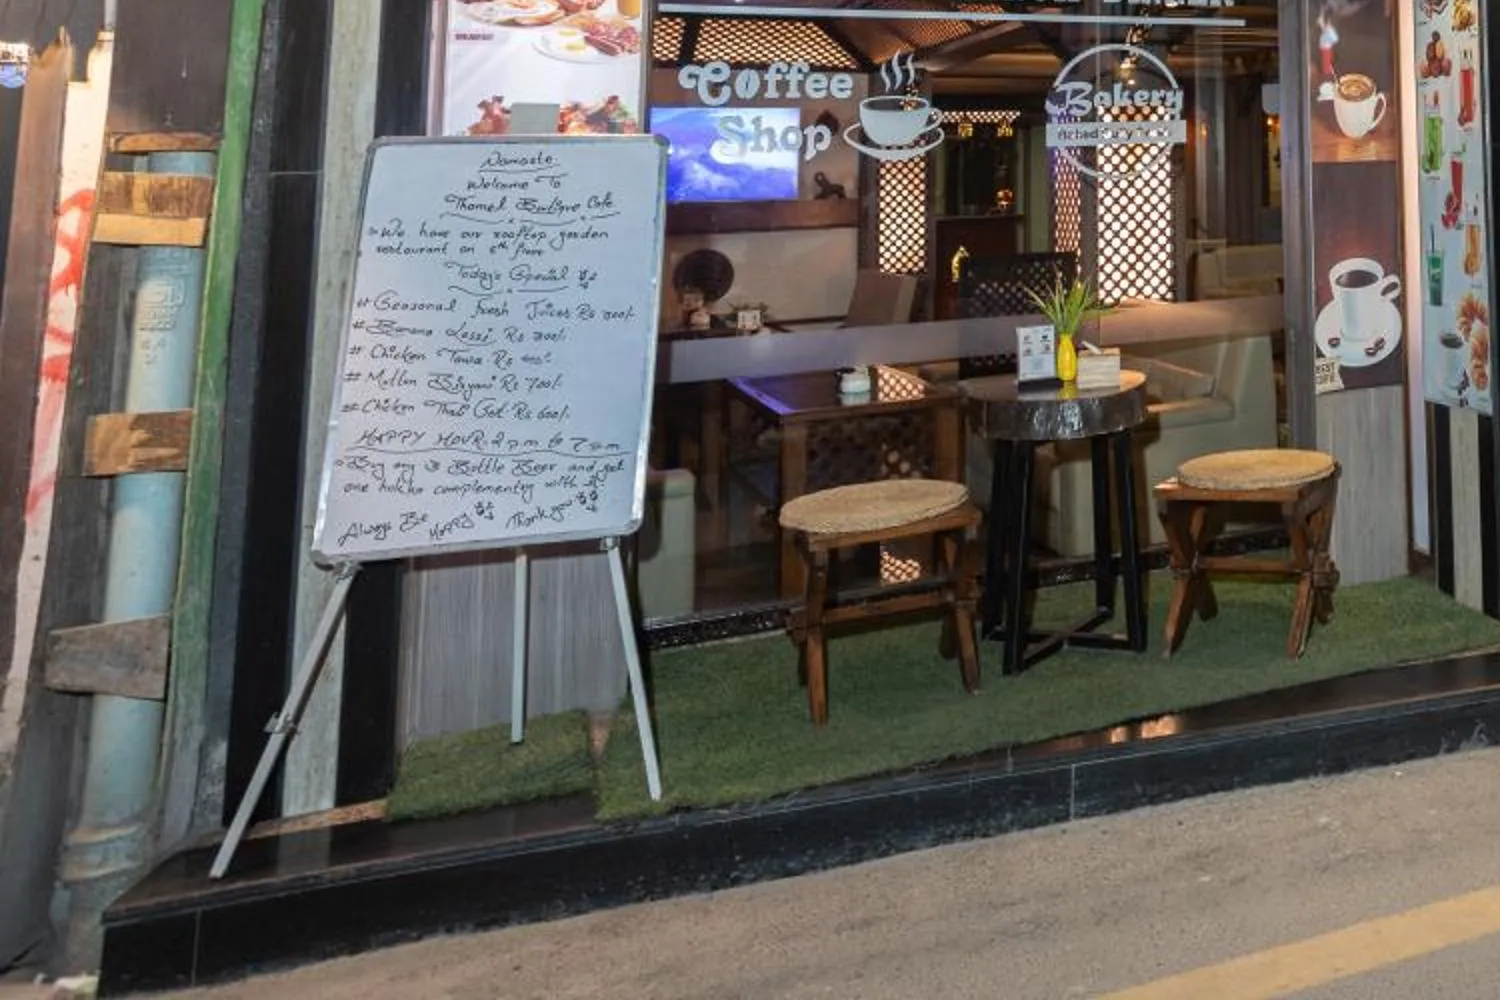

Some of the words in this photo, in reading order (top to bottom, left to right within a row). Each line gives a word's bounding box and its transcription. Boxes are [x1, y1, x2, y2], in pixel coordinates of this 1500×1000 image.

[678, 60, 854, 106] Coffee
[1045, 81, 1183, 120] Bakery
[711, 115, 832, 162] Shop
[444, 193, 508, 213] Thamel
[467, 177, 529, 191] Welcome
